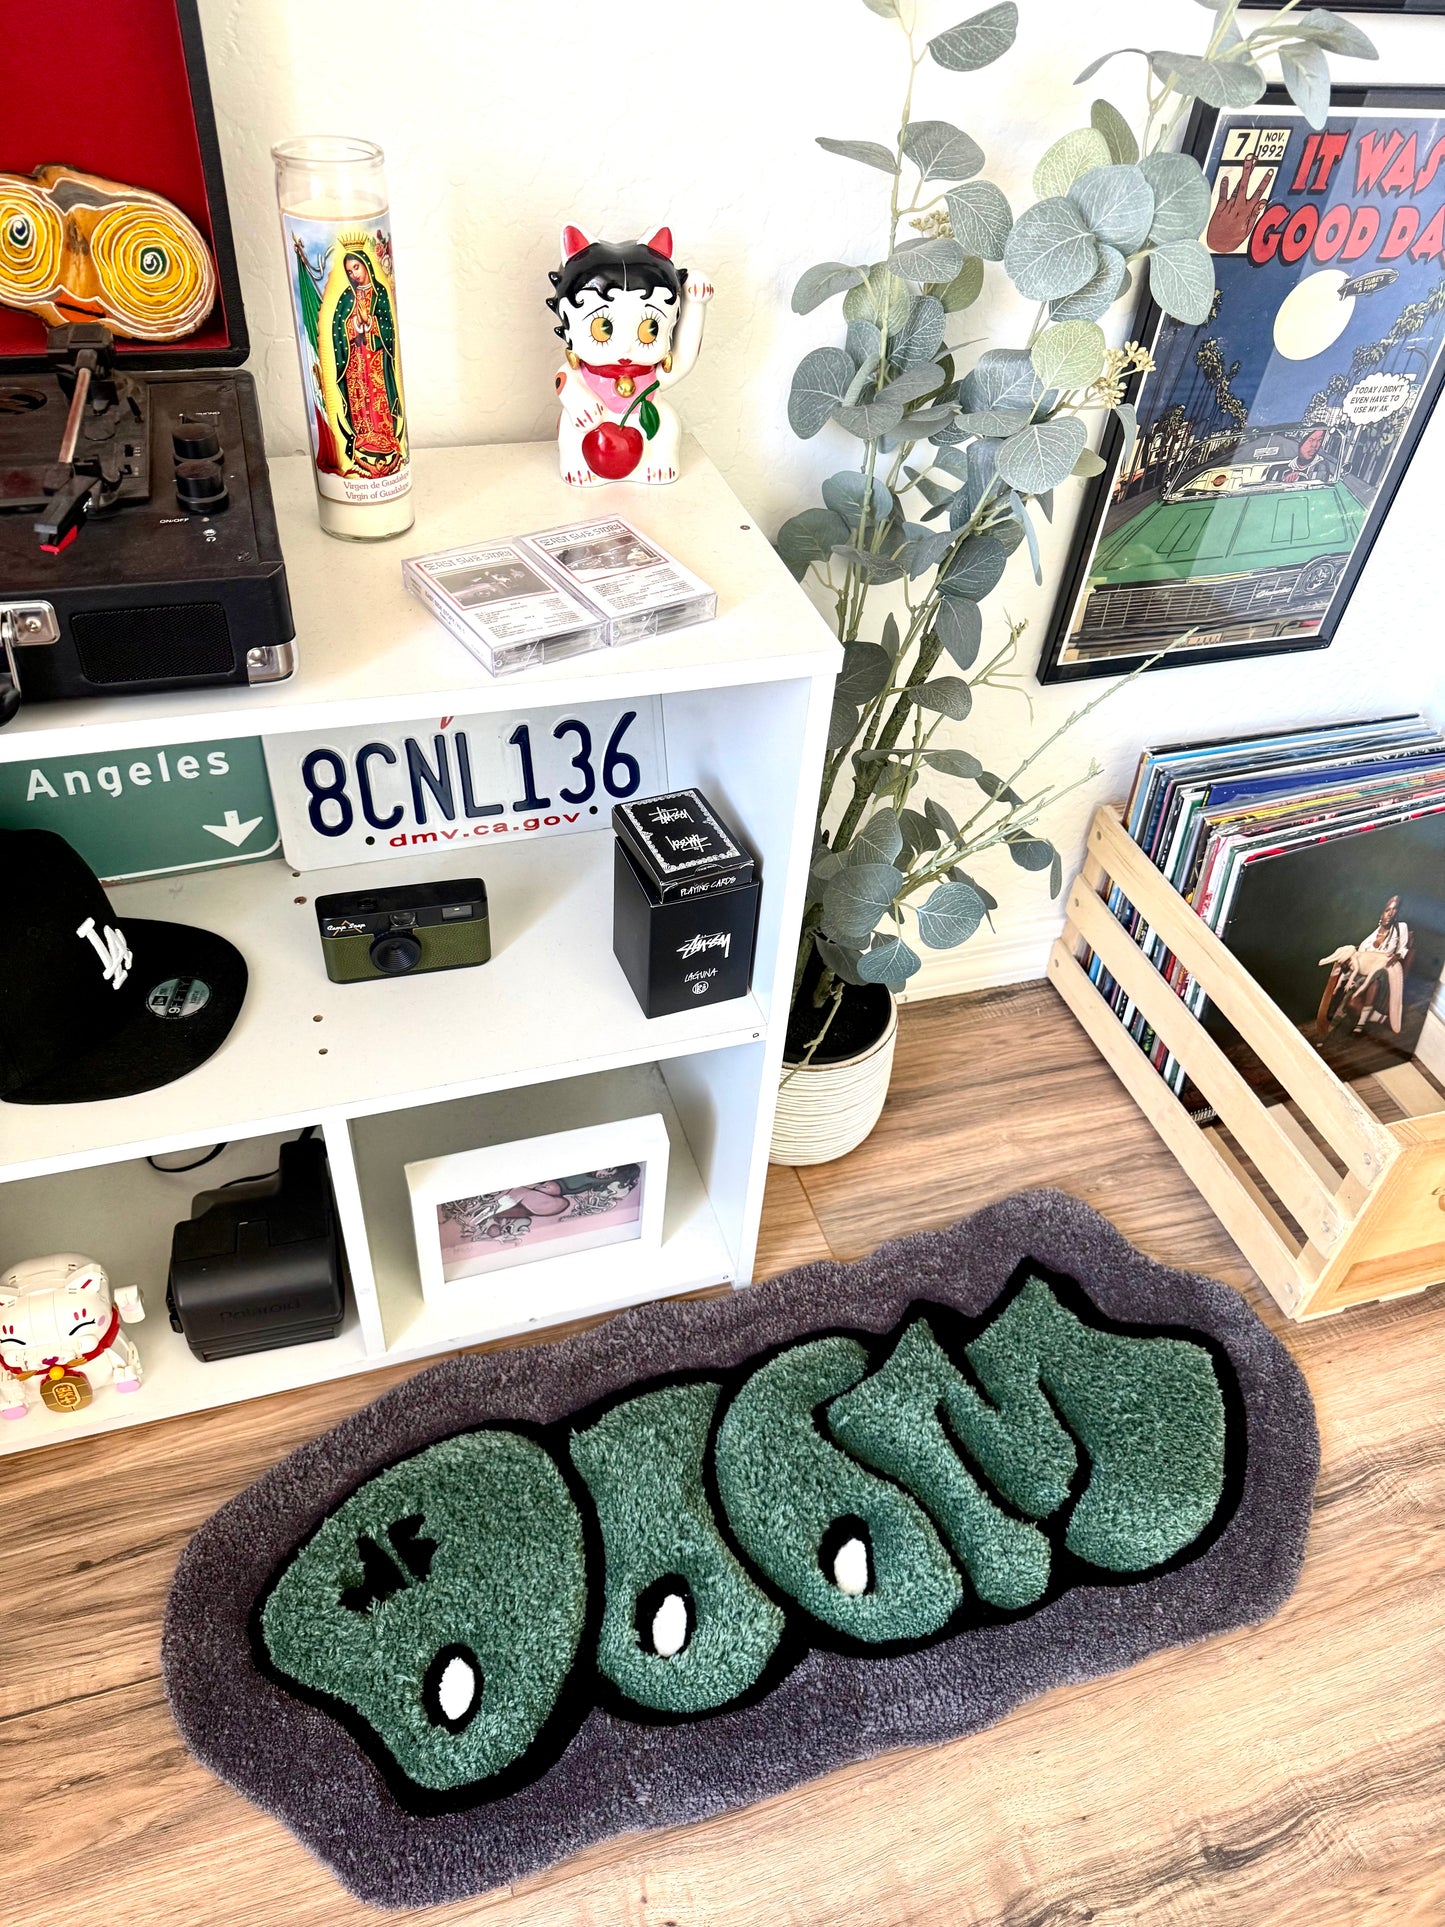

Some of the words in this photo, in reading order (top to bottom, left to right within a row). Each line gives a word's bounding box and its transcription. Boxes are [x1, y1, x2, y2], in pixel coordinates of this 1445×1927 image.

[1234, 132, 1251, 157] 7
[1264, 131, 1285, 142] NOV.
[1257, 144, 1284, 157] 1992
[1290, 129, 1351, 193] IT
[1355, 129, 1445, 195] WAS
[1250, 203, 1381, 265] GOOD
[1379, 203, 1445, 263] DA
[1353, 280, 1364, 289] ICE
[1364, 275, 1385, 286] CUBE'S
[1363, 283, 1378, 291] PIMP
[1350, 396, 1369, 404] EVEN
[1370, 395, 1389, 403] HAVE
[1389, 394, 1400, 402] TO
[1354, 386, 1378, 395] TODAY
[1382, 384, 1405, 394] DIDN'T
[1353, 406, 1367, 414] USE
[1367, 405, 1379, 413] MY
[1379, 404, 1390, 412] AK
[343, 481, 369, 491] Virgen
[381, 471, 409, 487] Guadalup
[345, 491, 369, 501] Virgin
[370, 491, 378, 499] of
[380, 482, 409, 498] Guadalup
[25, 749, 231, 802] Angeles
[300, 710, 641, 837] 8CNL136
[388, 812, 581, 848] dmv.ca.gov
[680, 882, 710, 897] PLAYING
[710, 875, 737, 890] CARDS
[684, 967, 718, 983] LAGUNA
